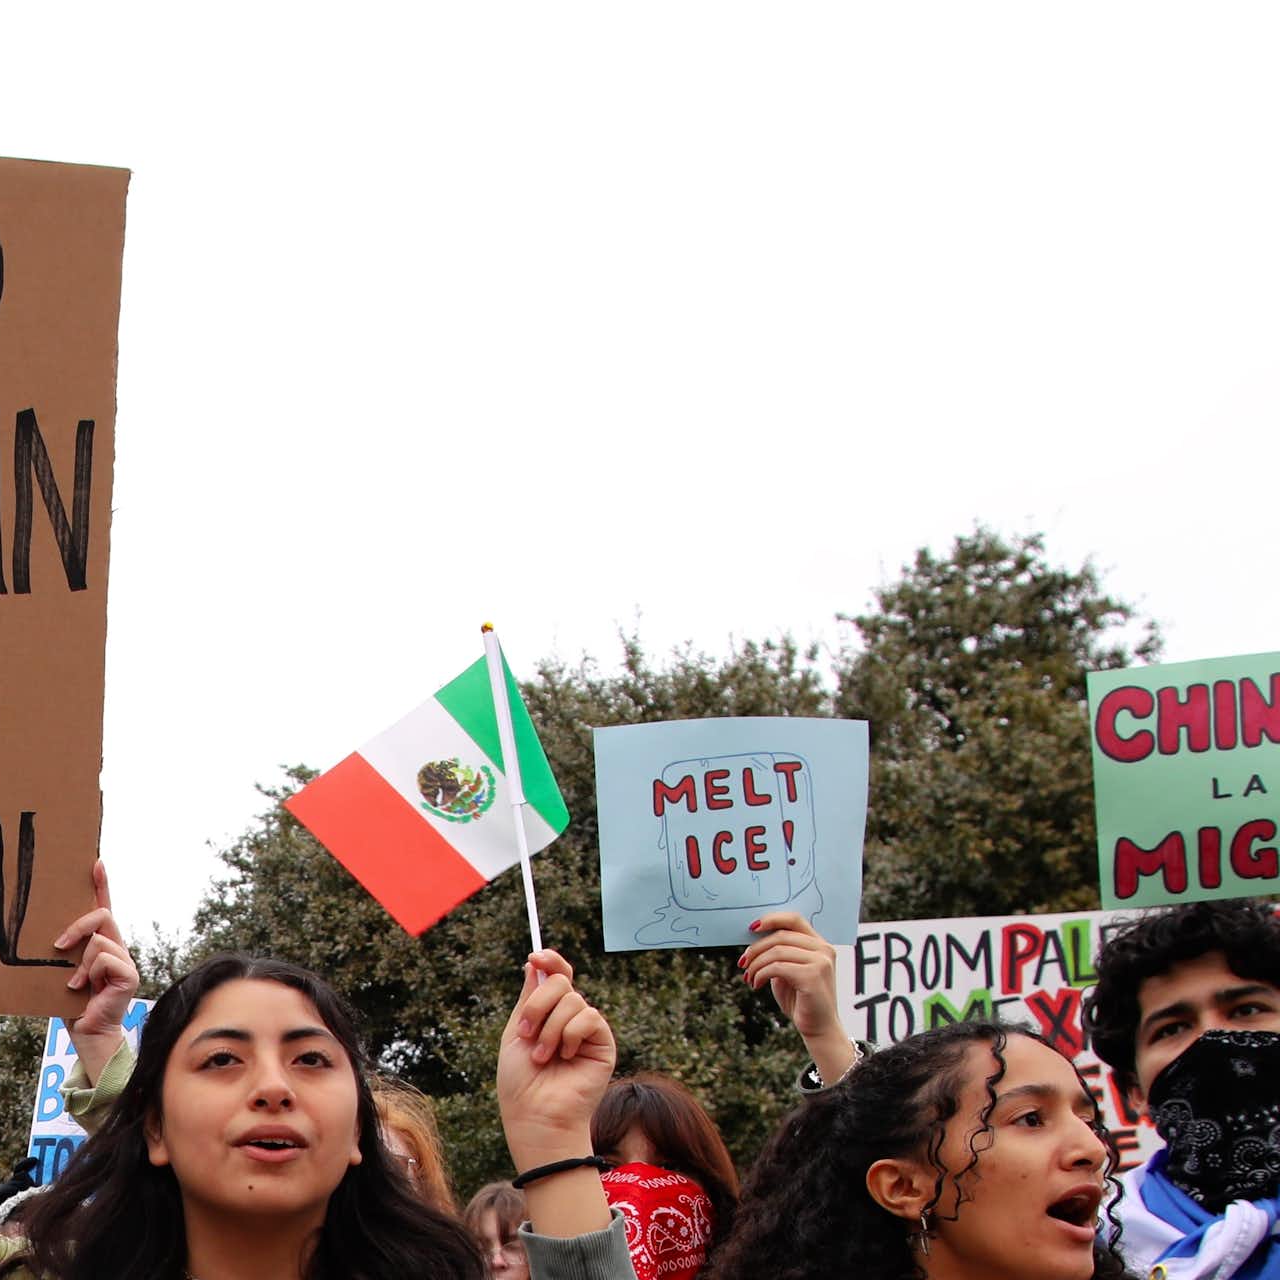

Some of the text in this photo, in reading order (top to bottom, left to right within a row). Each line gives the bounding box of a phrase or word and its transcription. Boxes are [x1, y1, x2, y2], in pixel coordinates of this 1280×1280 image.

[652, 761, 803, 818] MELT
[1211, 774, 1268, 799] LA
[686, 820, 797, 879] ICE!
[1114, 818, 1279, 900] MIG
[853, 930, 994, 994] FROM
[853, 993, 916, 1043] TO
